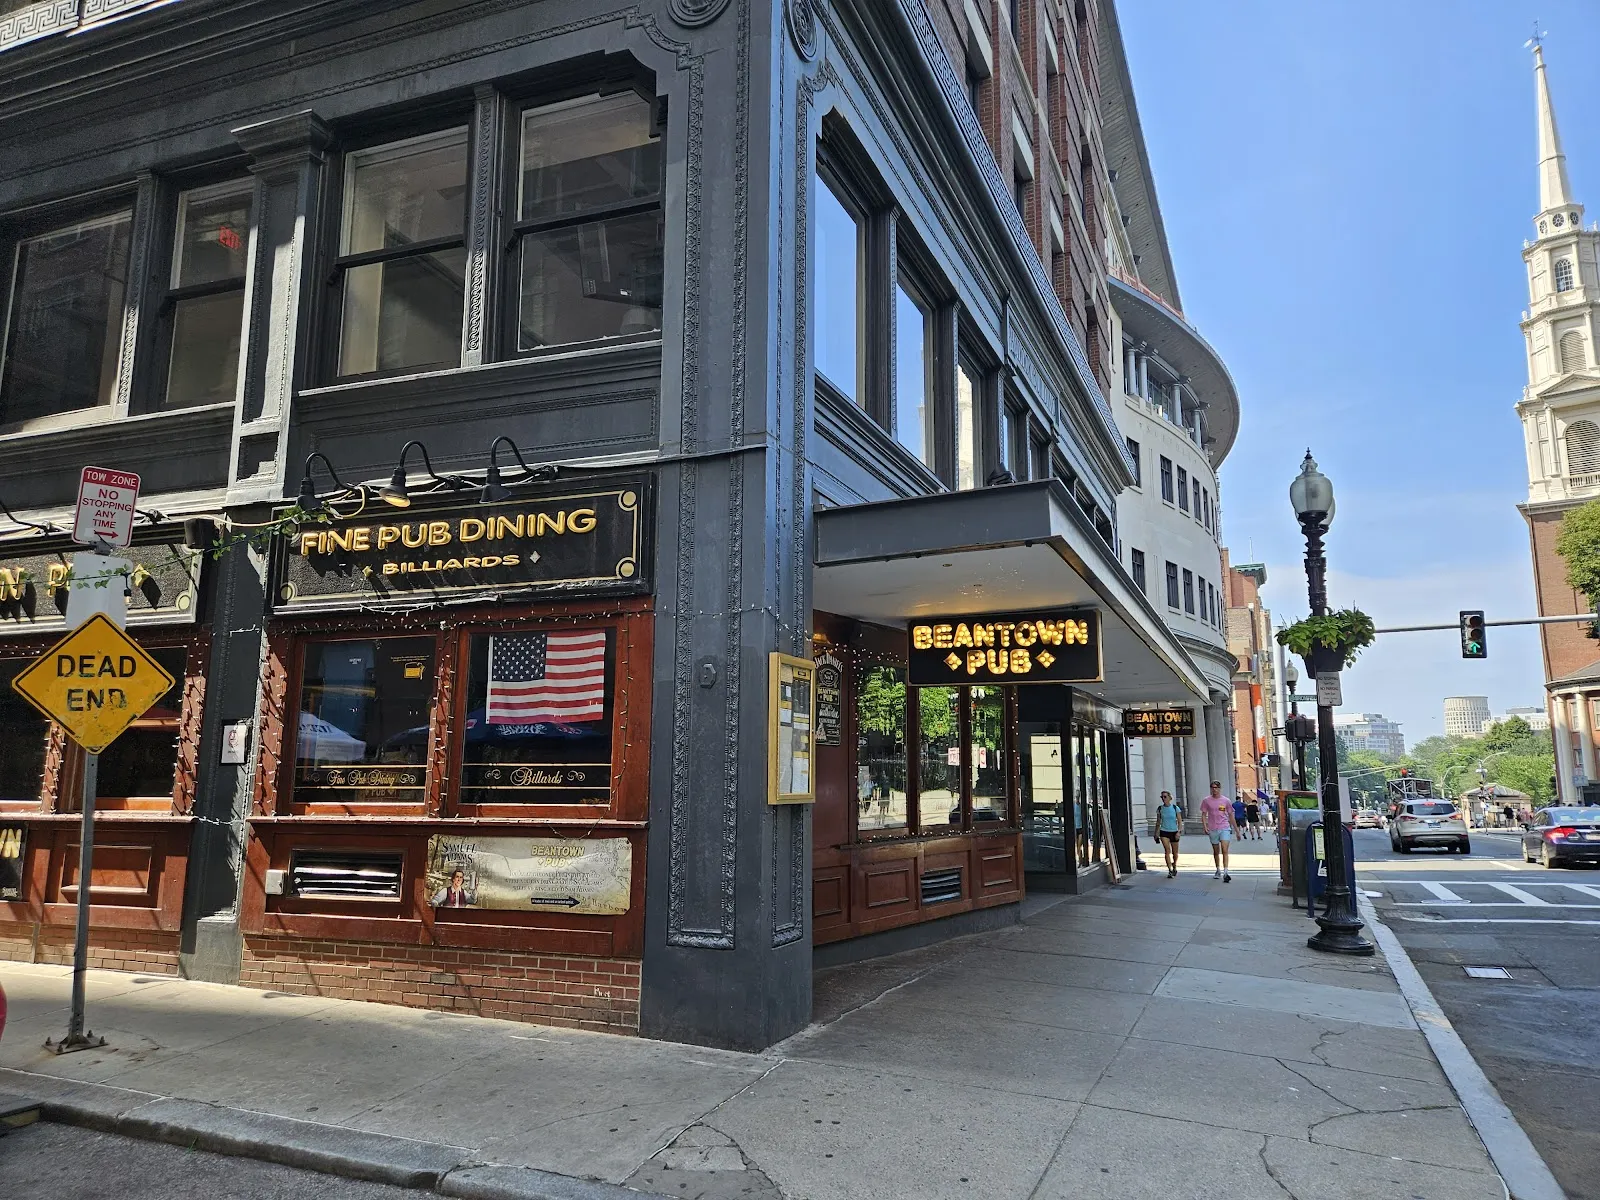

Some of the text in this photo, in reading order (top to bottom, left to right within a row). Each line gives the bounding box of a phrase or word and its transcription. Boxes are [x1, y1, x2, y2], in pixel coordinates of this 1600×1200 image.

[86, 470, 137, 487] TOW ZONE
[98, 488, 119, 500] NO
[82, 497, 132, 512] STOPPING
[95, 509, 116, 519] ANY
[93, 518, 117, 529] TIME
[300, 508, 597, 556] FINE PUB DINING
[382, 554, 521, 575] BILLIARDS
[912, 618, 1089, 650] BEANTOWN
[57, 655, 137, 678] DEAD
[966, 648, 1033, 675] PUB
[66, 687, 129, 712] END
[1126, 711, 1191, 723] BEANTOWN
[1146, 723, 1171, 734] PUB
[327, 769, 346, 786] Fine
[368, 769, 395, 787] Dining
[510, 766, 564, 786] Billards
[442, 842, 477, 853] SAMUEL
[531, 845, 585, 857] BEANTOWN
[445, 852, 473, 864] ADAMS
[544, 857, 567, 868] PUB
